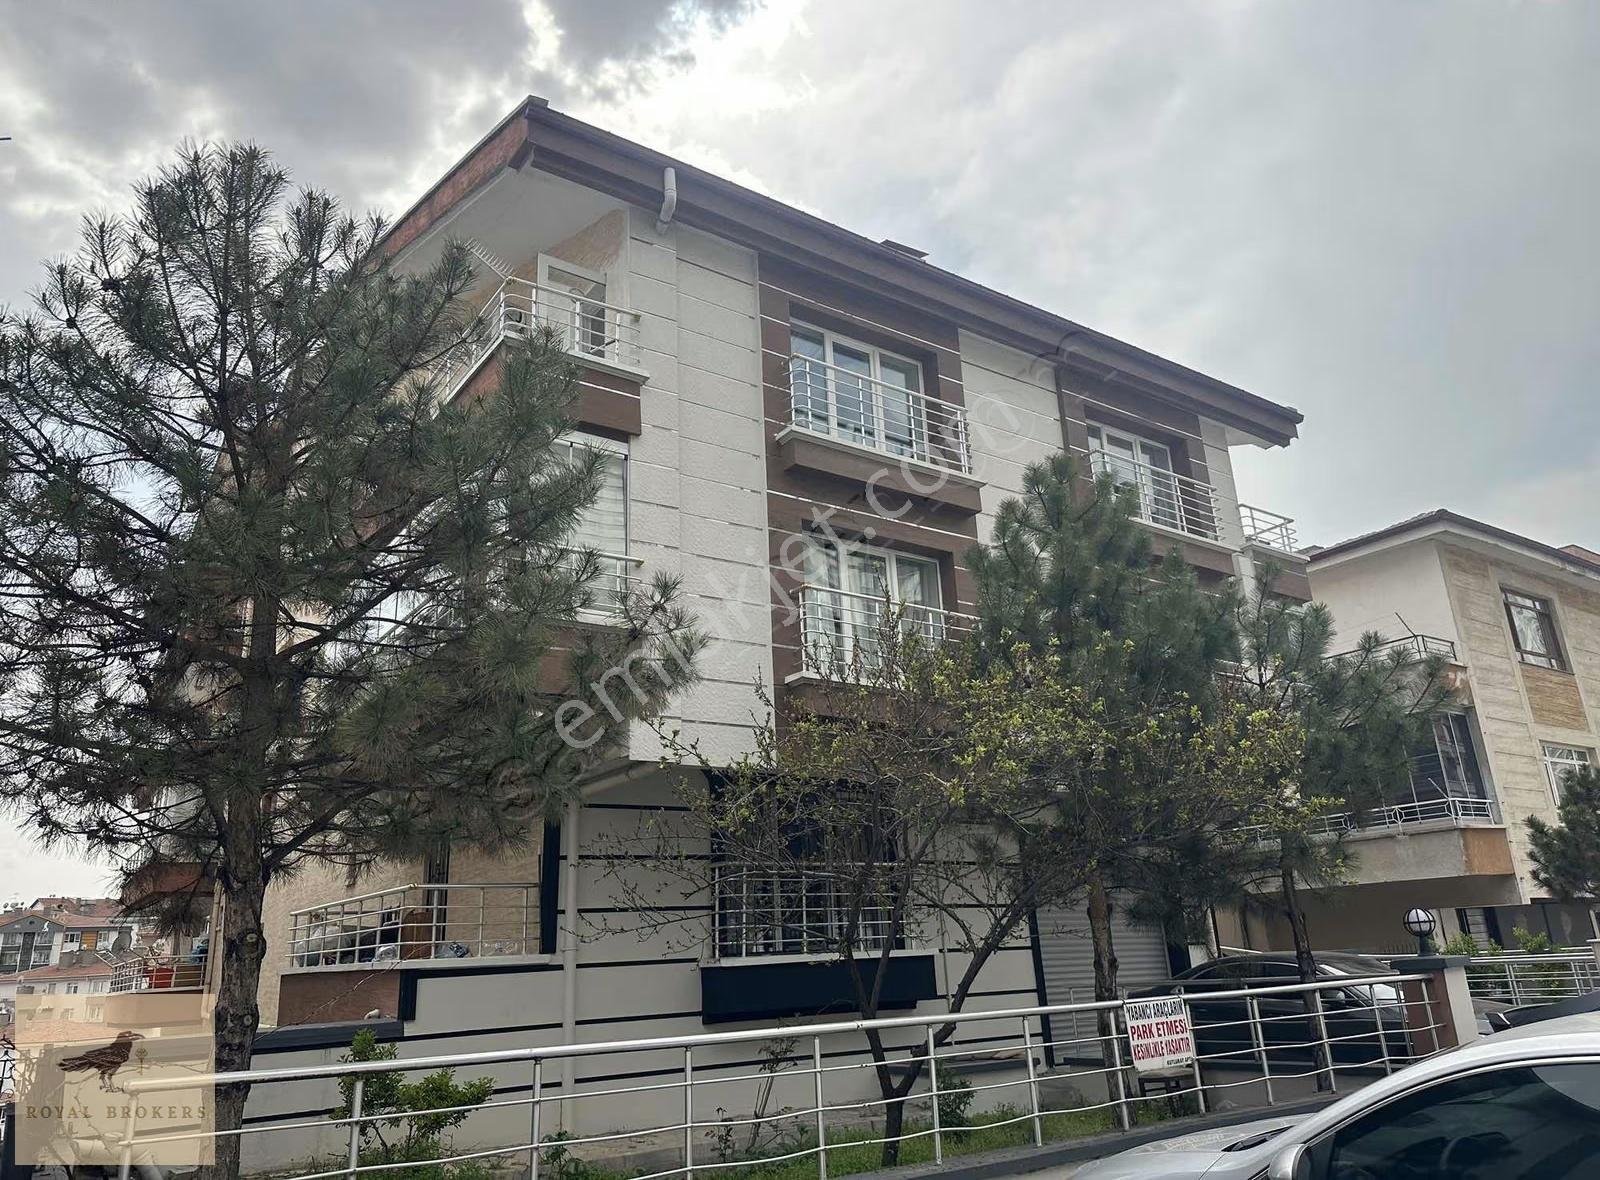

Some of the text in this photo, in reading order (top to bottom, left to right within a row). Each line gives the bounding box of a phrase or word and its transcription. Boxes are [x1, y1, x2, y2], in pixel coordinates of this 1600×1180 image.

[1127, 1000, 1184, 1021] YABANCI ARAÇLARIN
[1130, 1018, 1188, 1041] PARK ETMESİ
[1164, 1036, 1191, 1056] YASAKTIR
